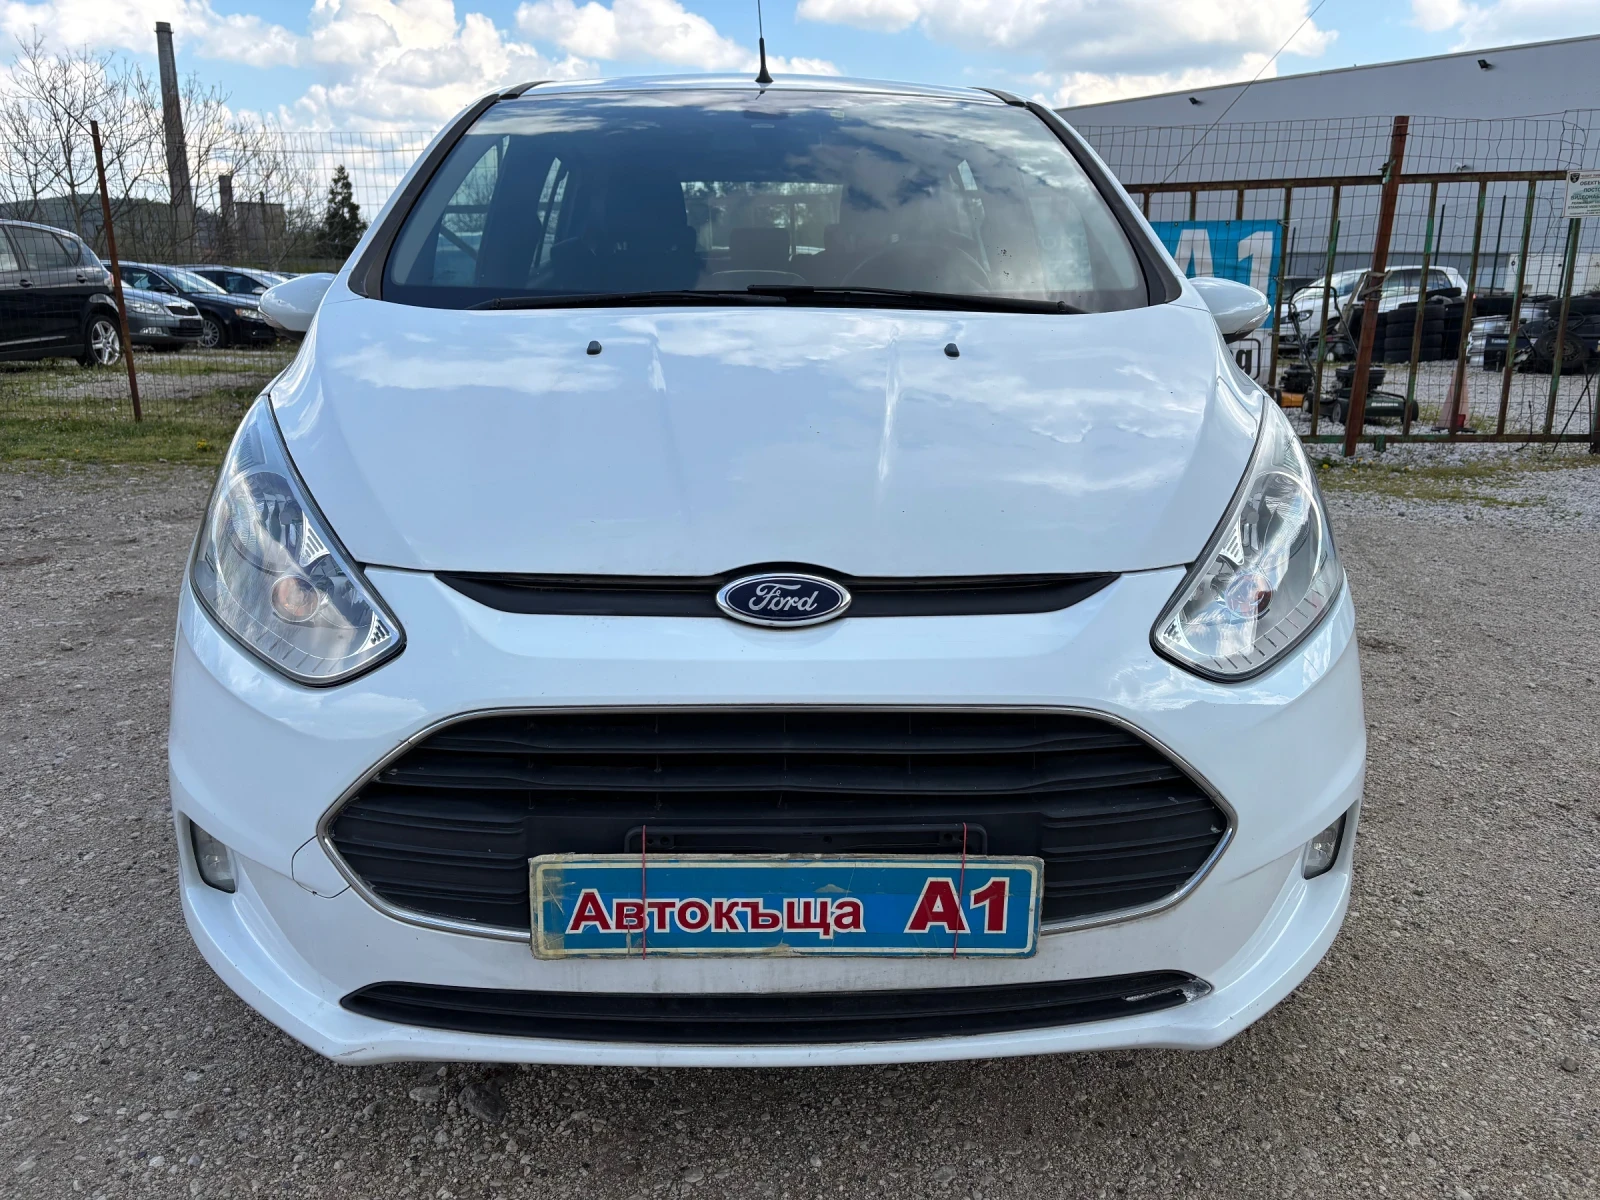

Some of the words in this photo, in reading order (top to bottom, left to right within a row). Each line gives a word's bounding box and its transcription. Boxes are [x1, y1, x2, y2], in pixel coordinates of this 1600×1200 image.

[748, 582, 819, 611] Ford
[565, 888, 866, 939] Автокъща
[904, 877, 1010, 934] А1
